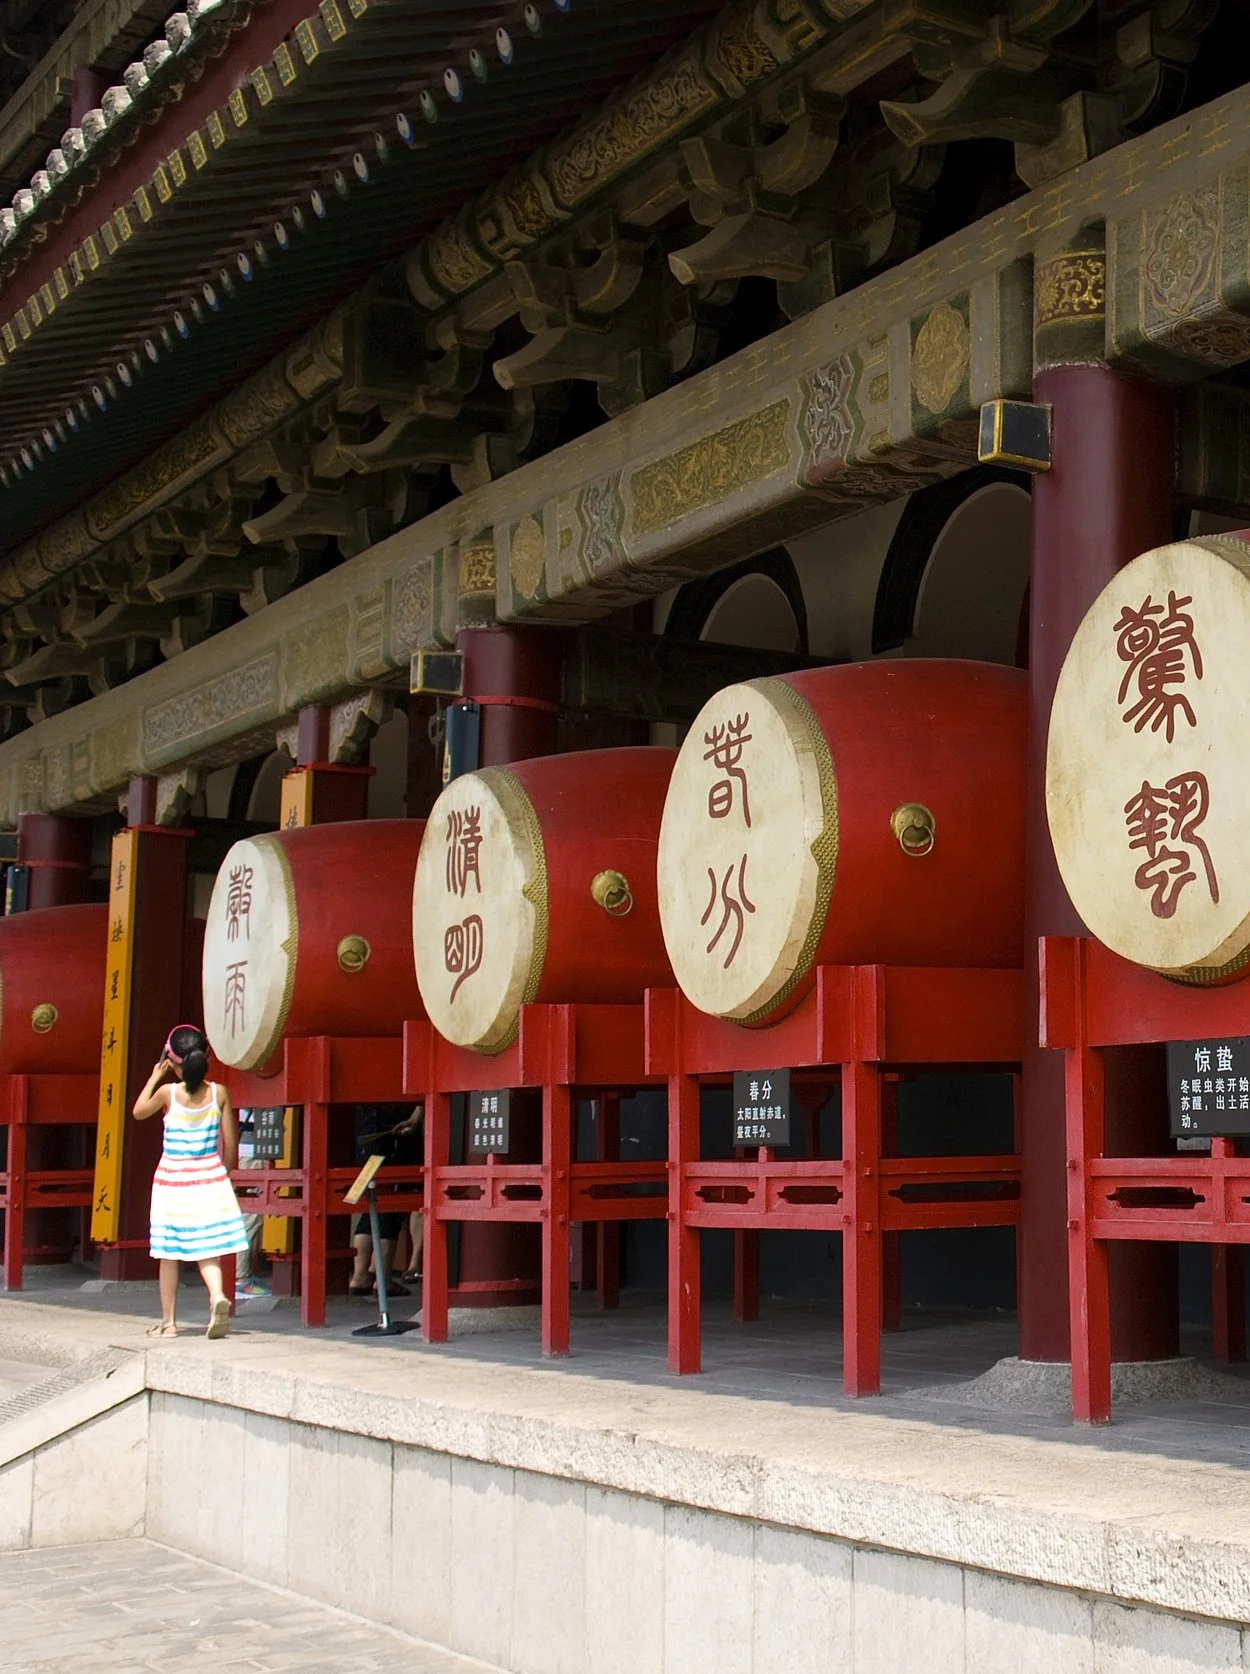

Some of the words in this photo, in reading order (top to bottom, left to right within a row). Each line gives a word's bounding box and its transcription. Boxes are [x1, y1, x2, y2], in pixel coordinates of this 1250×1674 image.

[1194, 1045, 1234, 1073] 惊蛰
[749, 1079, 773, 1101] 春分
[1180, 1076, 1250, 1094] 冬眠虫类开始
